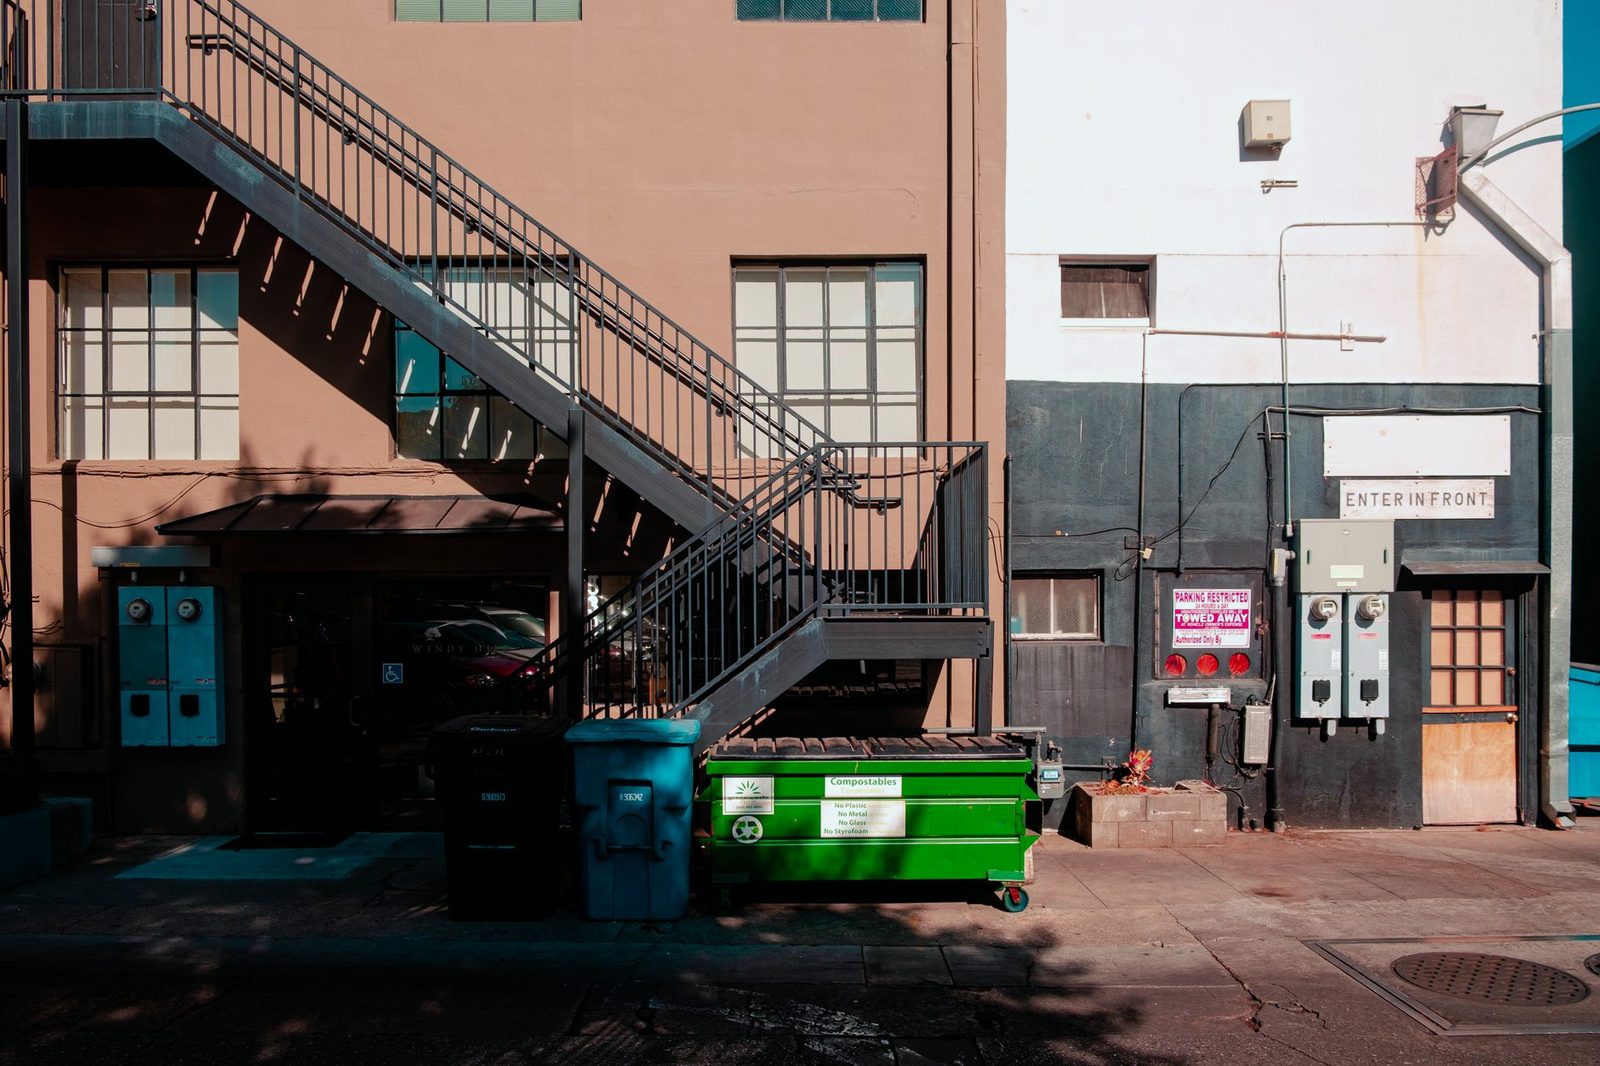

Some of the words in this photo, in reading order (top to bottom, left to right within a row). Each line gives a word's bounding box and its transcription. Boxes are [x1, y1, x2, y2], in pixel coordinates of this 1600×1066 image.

[1346, 492, 1403, 507] ENTER
[1409, 492, 1424, 506] IN
[1431, 492, 1488, 506] FRONT
[1175, 592, 1205, 602] PARKING
[1207, 592, 1248, 602] RESTRICTED
[1175, 613, 1215, 623] TOWED
[1216, 613, 1248, 623] AWAY
[1176, 635, 1202, 643] Authorized
[1203, 635, 1214, 645] Only
[1215, 635, 1222, 646] By
[411, 644, 465, 653] WINDY
[830, 777, 897, 787] Compostables
